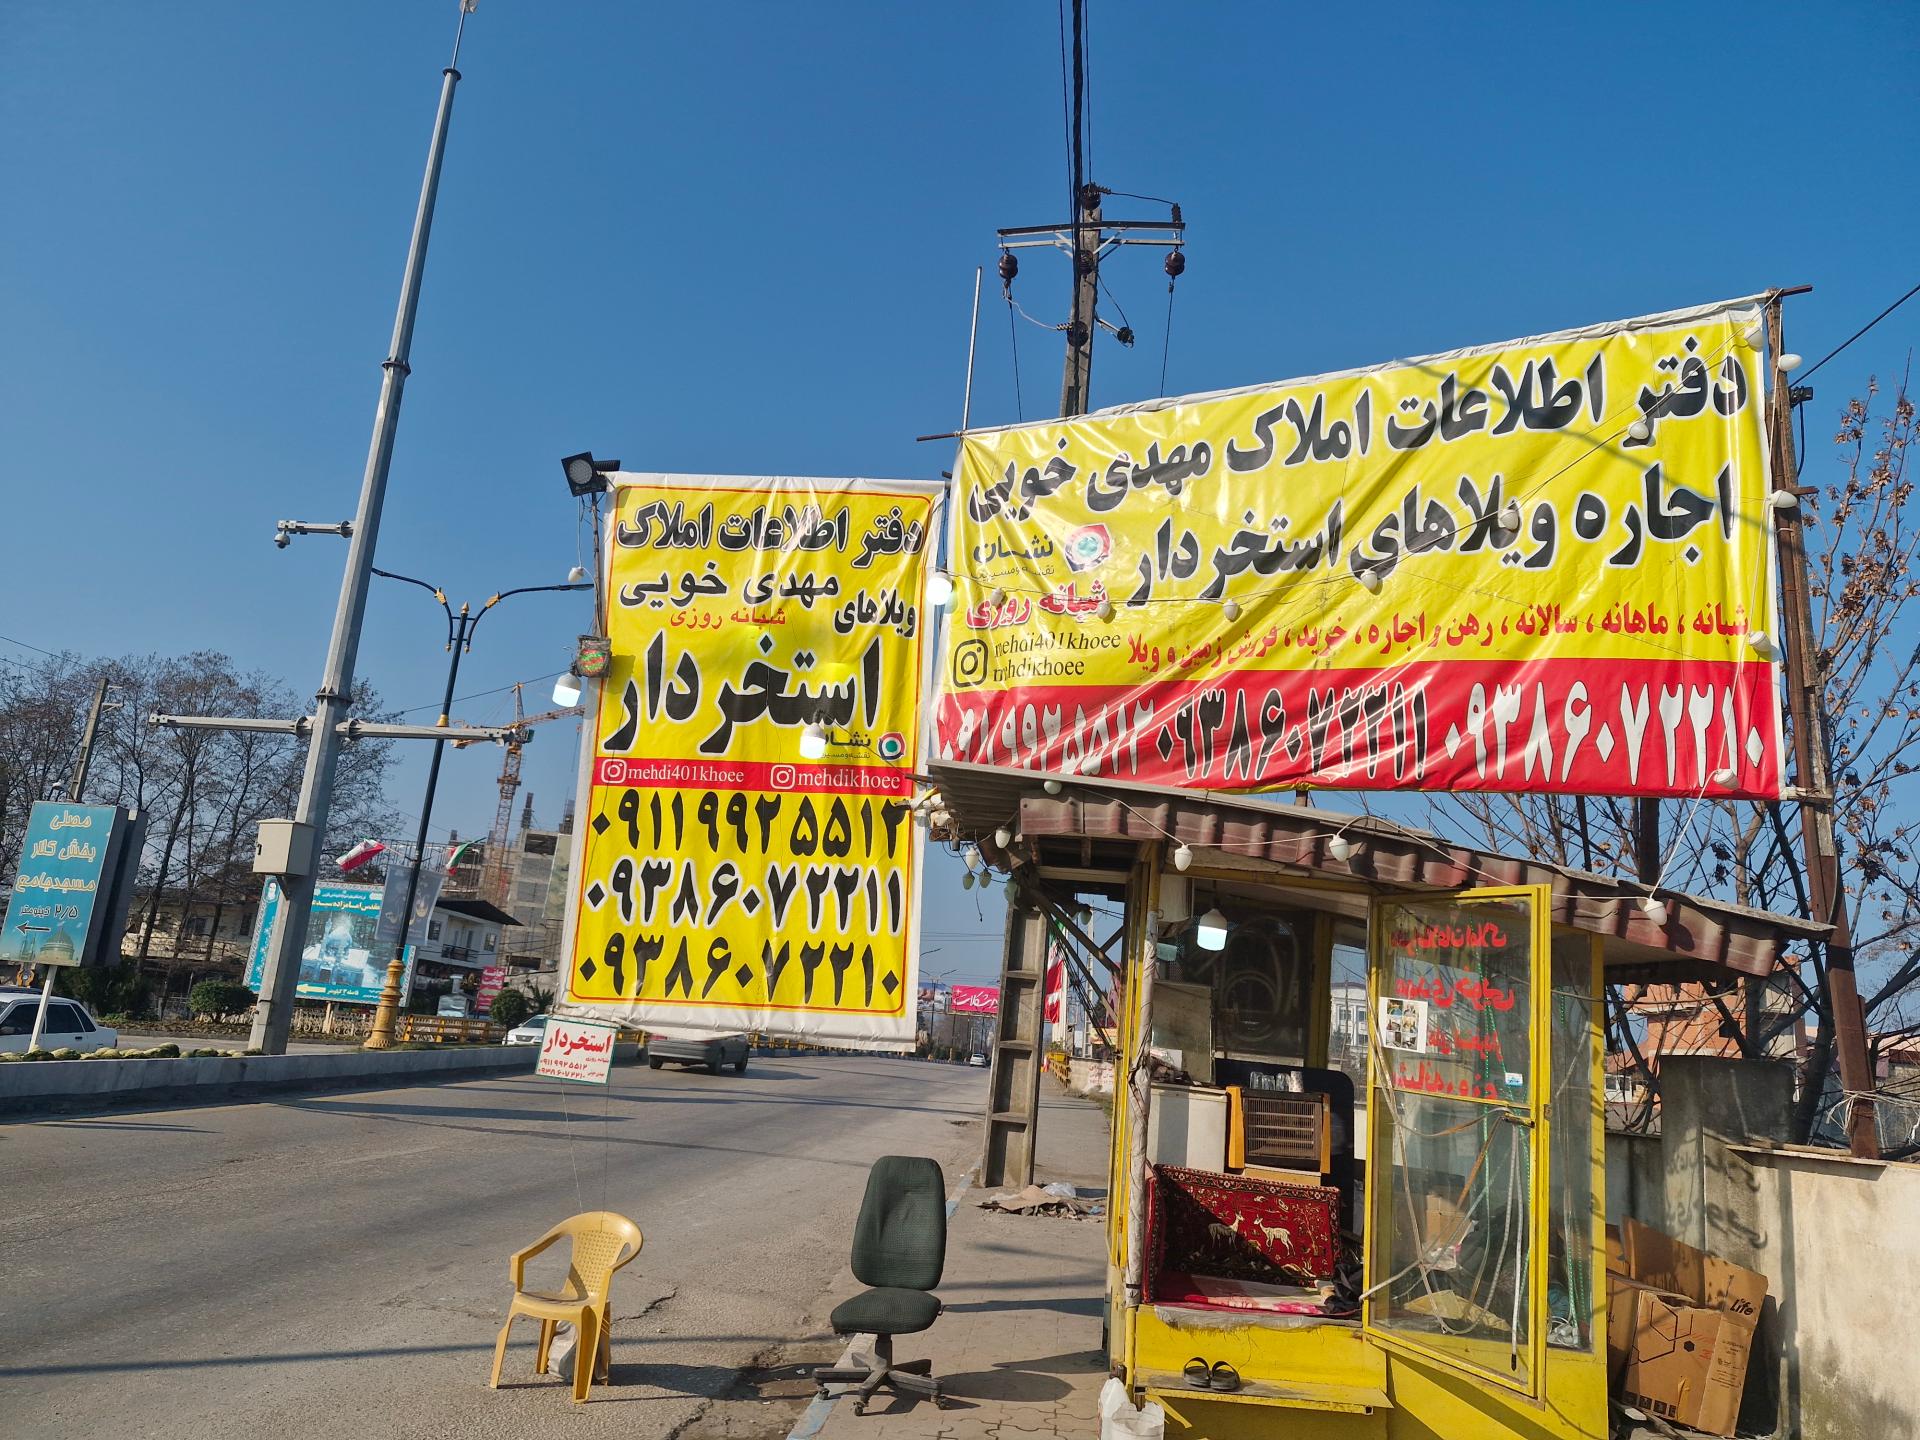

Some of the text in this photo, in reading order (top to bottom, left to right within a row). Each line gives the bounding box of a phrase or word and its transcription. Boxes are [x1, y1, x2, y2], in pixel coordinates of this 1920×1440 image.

[969, 337, 1746, 522] دفتر اطلاعات املاک مهدی خویی
[617, 502, 923, 568] دفتر اطلاعات املاک
[1351, 473, 1552, 579] ویلاهای
[1577, 463, 1734, 567] اجاره
[973, 534, 1054, 563] نشان
[620, 561, 839, 609] مهدی خویی
[967, 580, 1107, 628] شبانه روزی
[670, 607, 786, 631] شبانه روزی
[835, 588, 915, 638] ویلاهای
[1368, 611, 1425, 655] اجاره
[1446, 612, 1493, 648] رهن
[1516, 602, 1577, 637] سالانه
[1601, 601, 1669, 635] ماهانه
[1445, 680, 1764, 787] ۰۹۳۸۶۰۷۲۲۱۰
[628, 765, 744, 783] mehdi401khoee
[798, 764, 900, 789] mehdikhoee
[588, 859, 901, 934] ۰۹۳۸۶۰۷۲۲۱۱
[579, 933, 899, 1007] ۰۹۳۸۶۰۷۲۲۱۰
